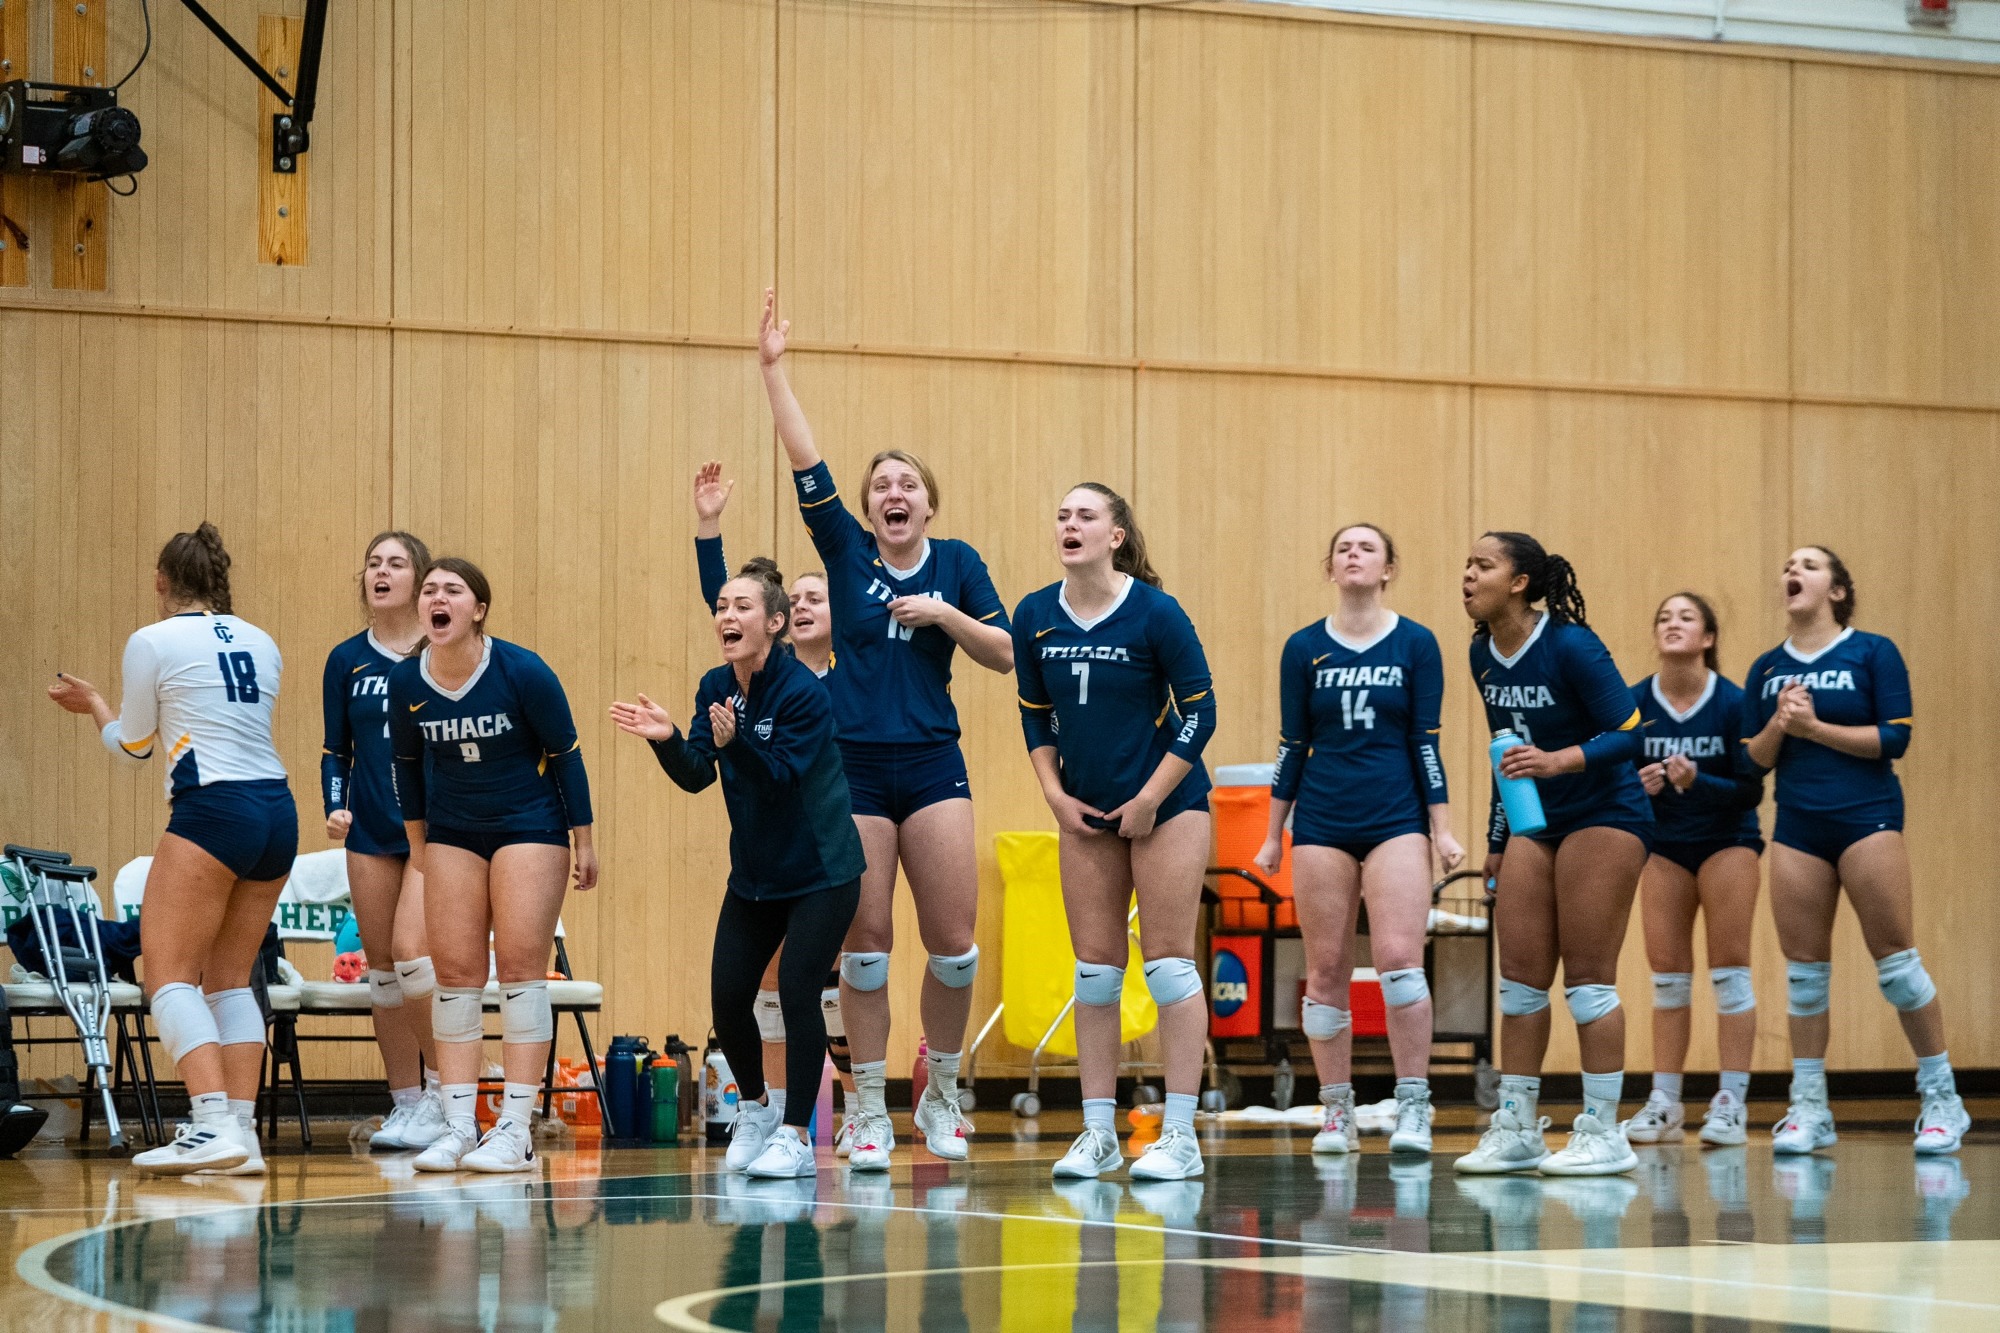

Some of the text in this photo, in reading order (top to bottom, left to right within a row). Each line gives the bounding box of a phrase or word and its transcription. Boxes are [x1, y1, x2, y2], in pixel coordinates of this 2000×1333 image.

[217, 651, 259, 704] 18
[352, 676, 390, 697] ITH
[1071, 662, 1090, 705] 7
[1315, 666, 1404, 689] ITHACA
[1340, 689, 1376, 730] 14
[1484, 684, 1556, 708] ITHACA
[419, 713, 513, 742] ITHACA
[1644, 736, 1725, 758] ITHACA
[1419, 744, 1444, 790] ITHACA
